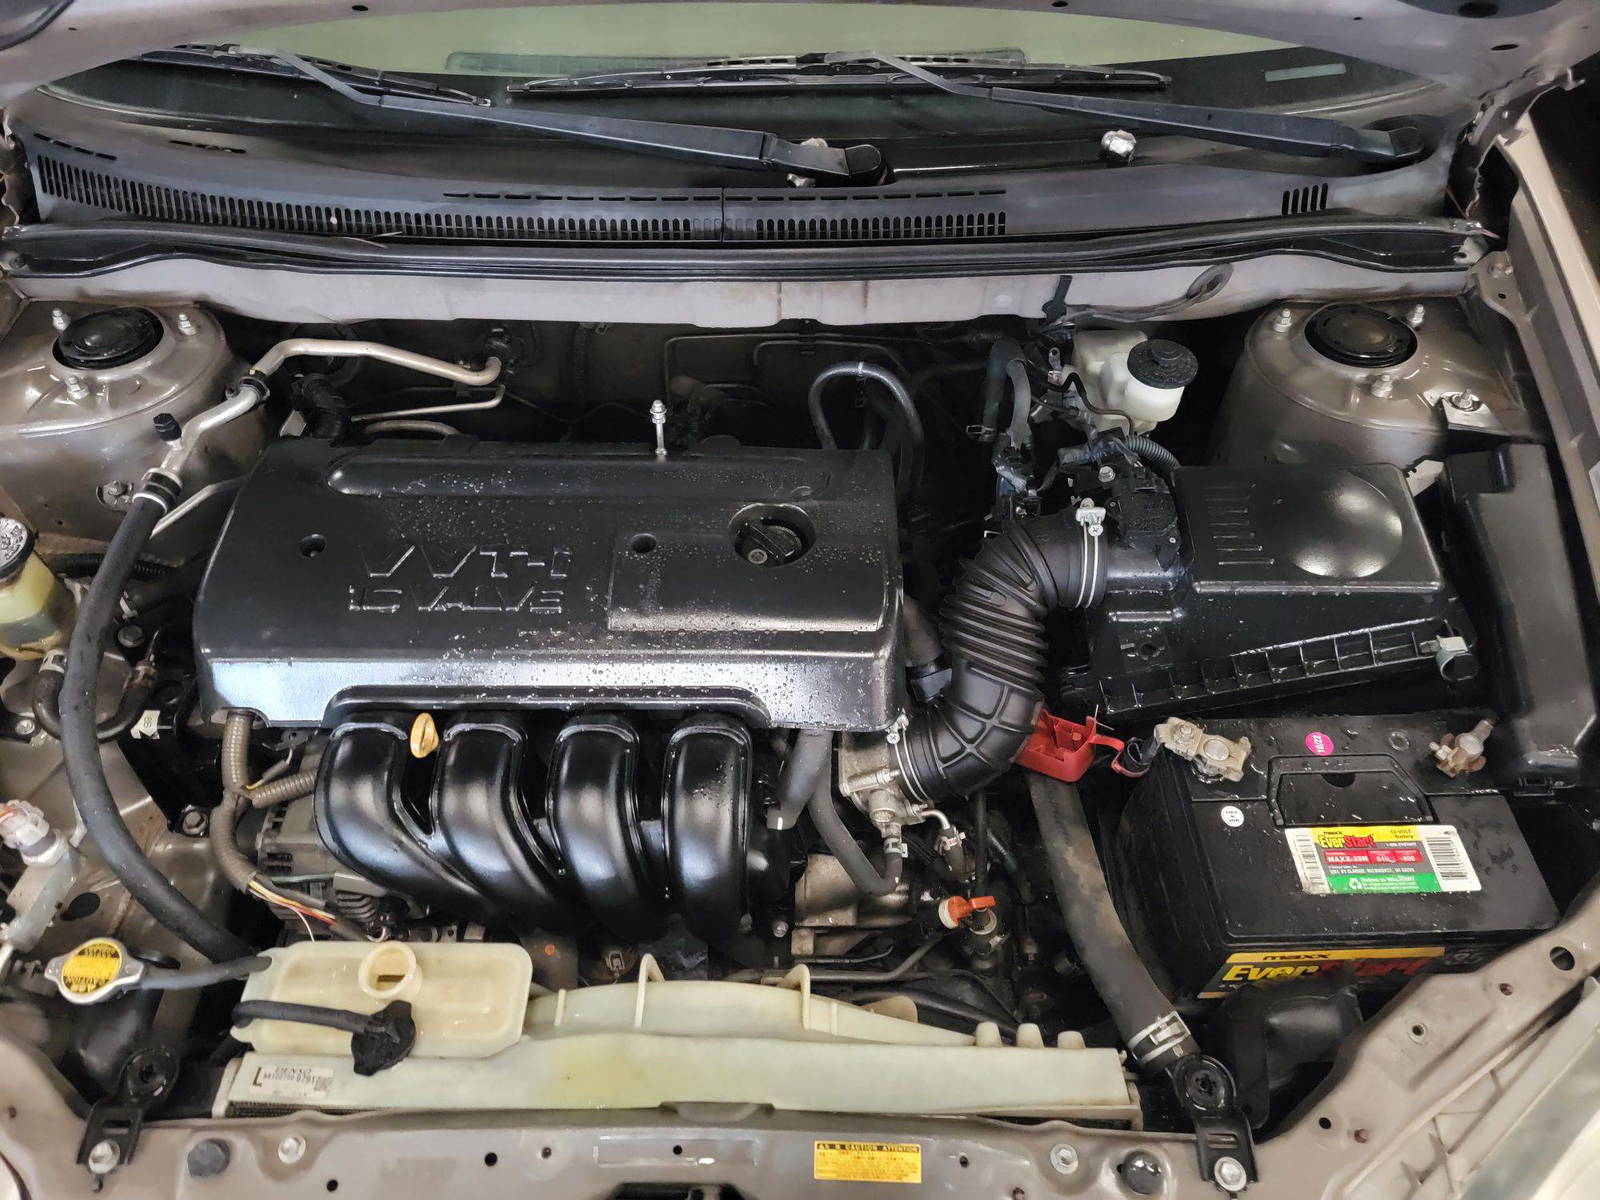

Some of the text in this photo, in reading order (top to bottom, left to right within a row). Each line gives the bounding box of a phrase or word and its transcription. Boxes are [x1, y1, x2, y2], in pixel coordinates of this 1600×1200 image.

[409, 584, 566, 614] VALVE
[1317, 833, 1377, 849] EverStart
[1262, 953, 1331, 961] maxx
